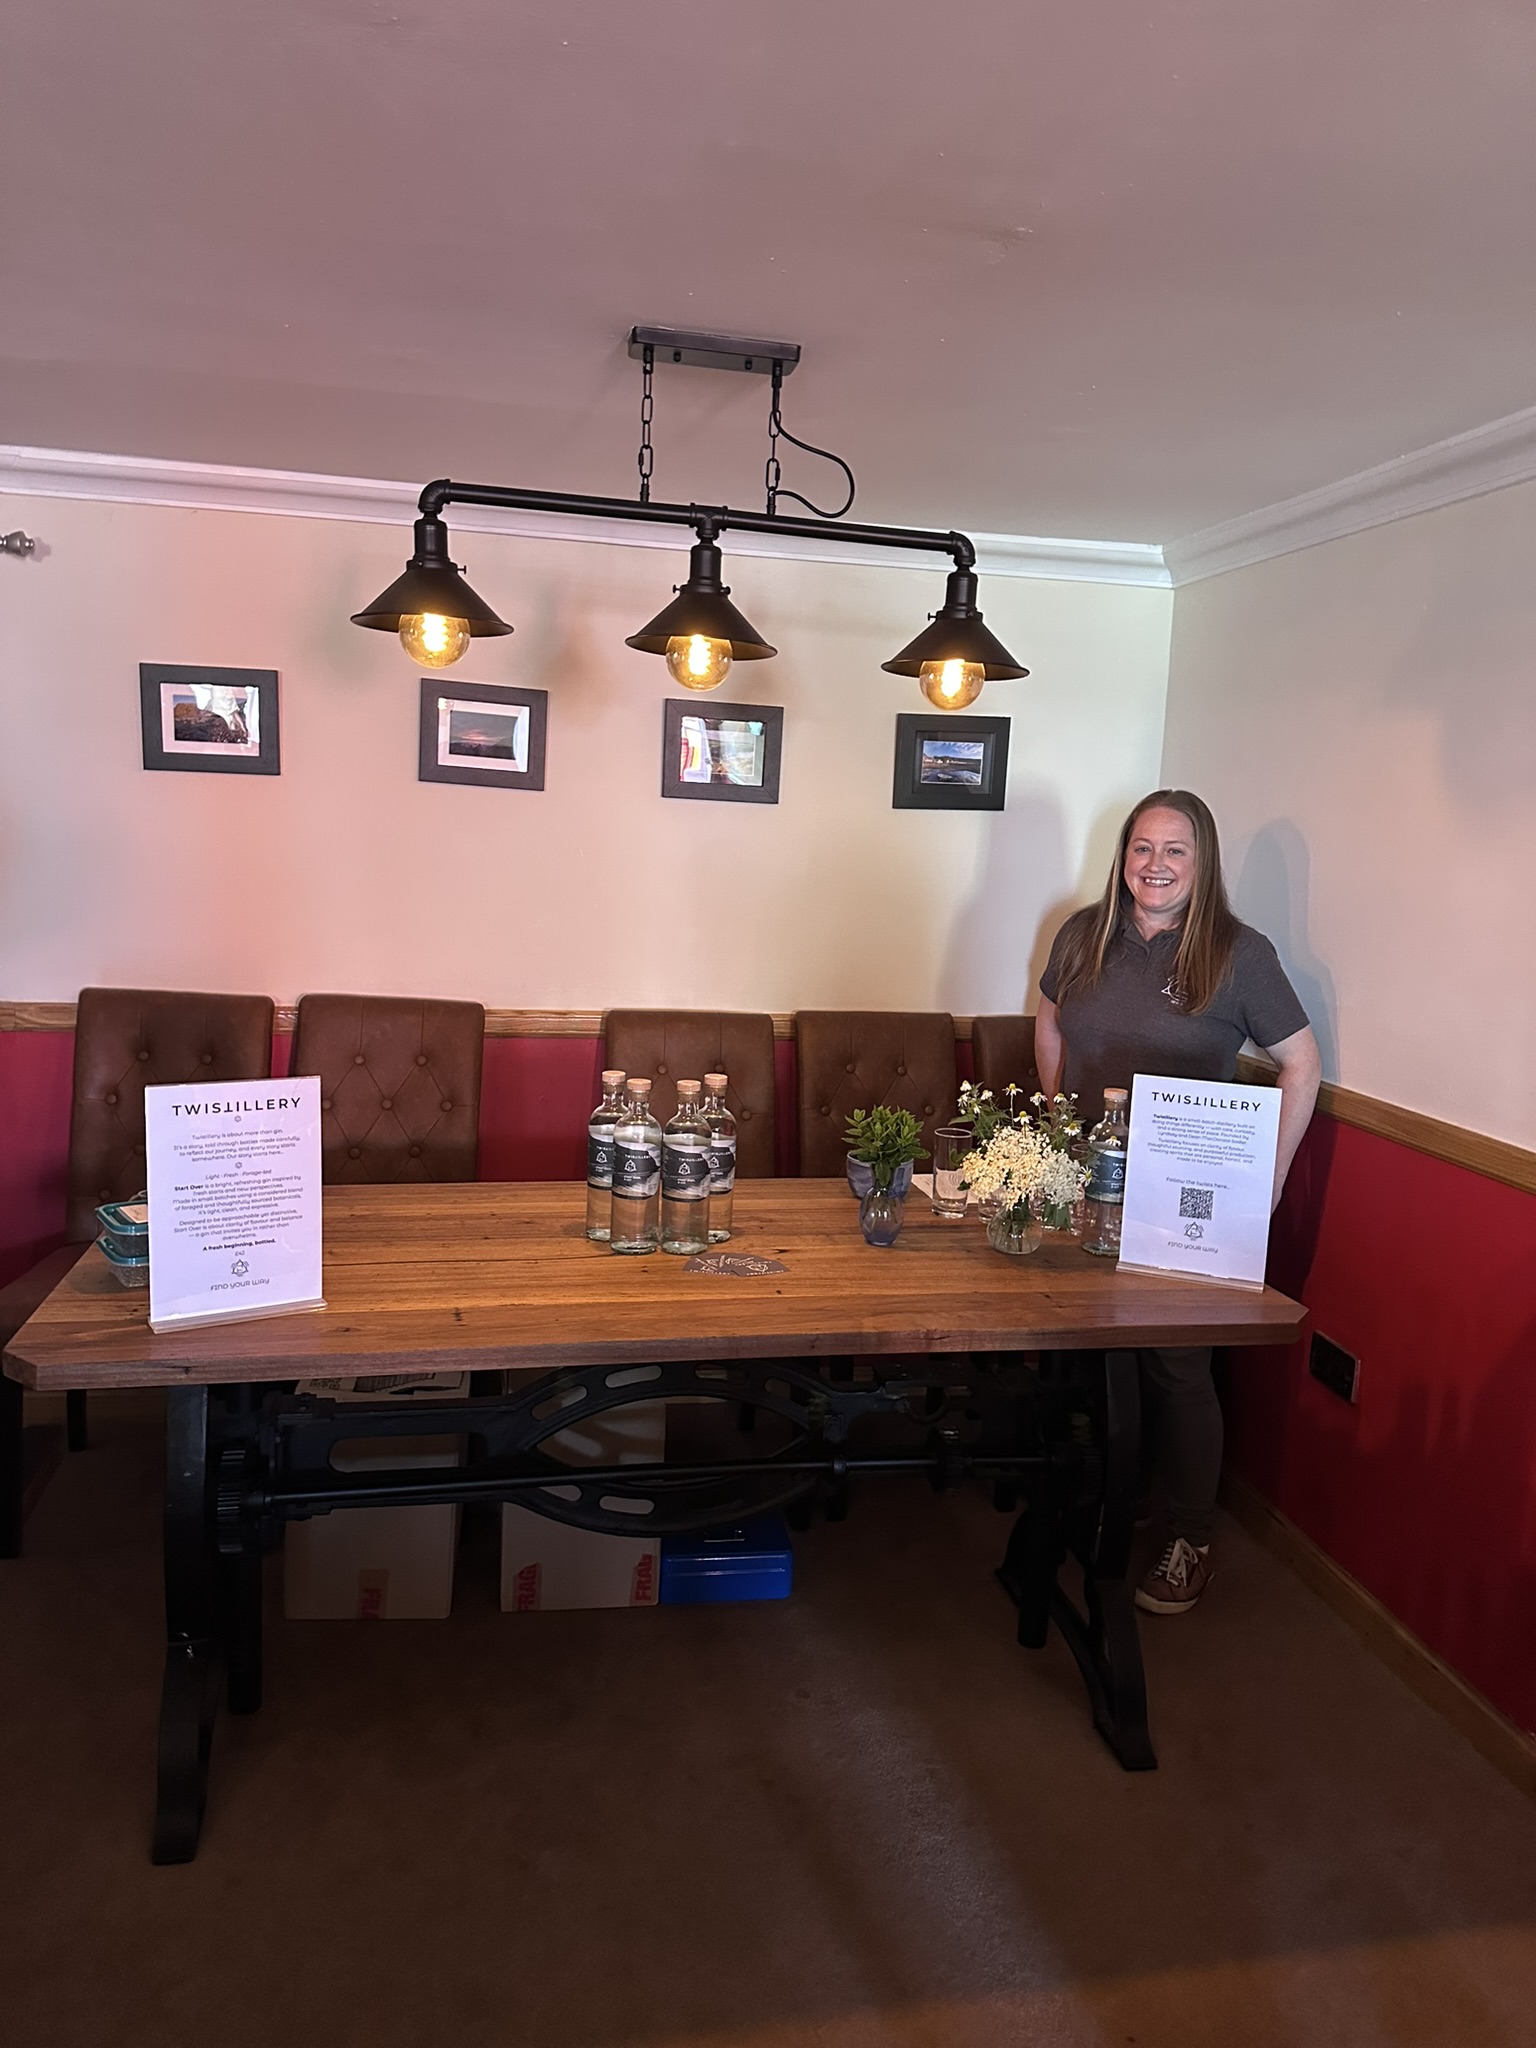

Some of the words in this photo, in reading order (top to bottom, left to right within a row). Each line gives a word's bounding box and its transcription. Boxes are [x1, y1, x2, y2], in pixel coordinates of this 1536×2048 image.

[171, 1097, 301, 1116] TWISTILLERY
[1151, 1092, 1261, 1112] TWISTILLERY
[205, 1173, 220, 1181] Light
[1167, 1241, 1183, 1249] FIND
[210, 1283, 228, 1291] FIND
[229, 1280, 250, 1288] YOUR
